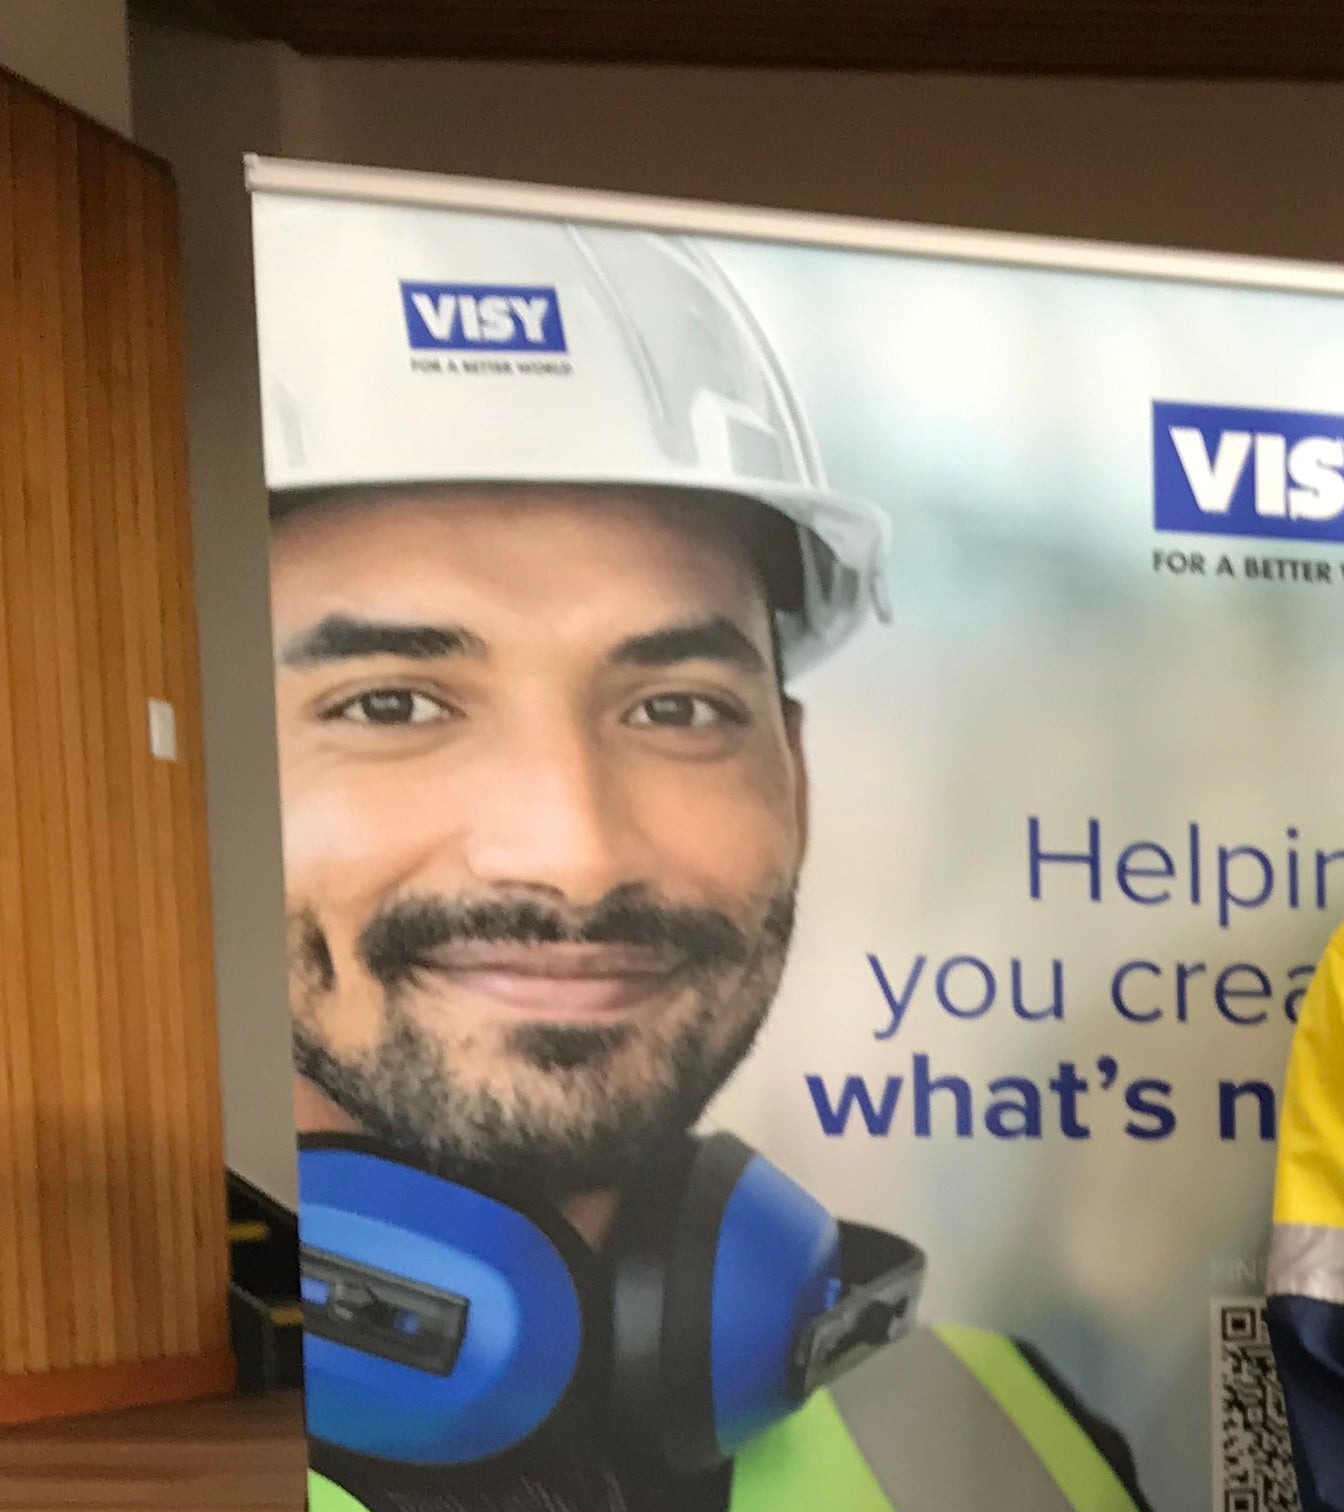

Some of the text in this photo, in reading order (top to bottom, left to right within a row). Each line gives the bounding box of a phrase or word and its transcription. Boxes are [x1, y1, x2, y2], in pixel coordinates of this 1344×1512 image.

[411, 292, 549, 344] VISY
[1152, 549, 1206, 576] FOR
[1215, 553, 1234, 577] A
[1244, 556, 1332, 584] BETTER
[865, 951, 1066, 1041] you
[804, 1051, 1177, 1142] what’s
